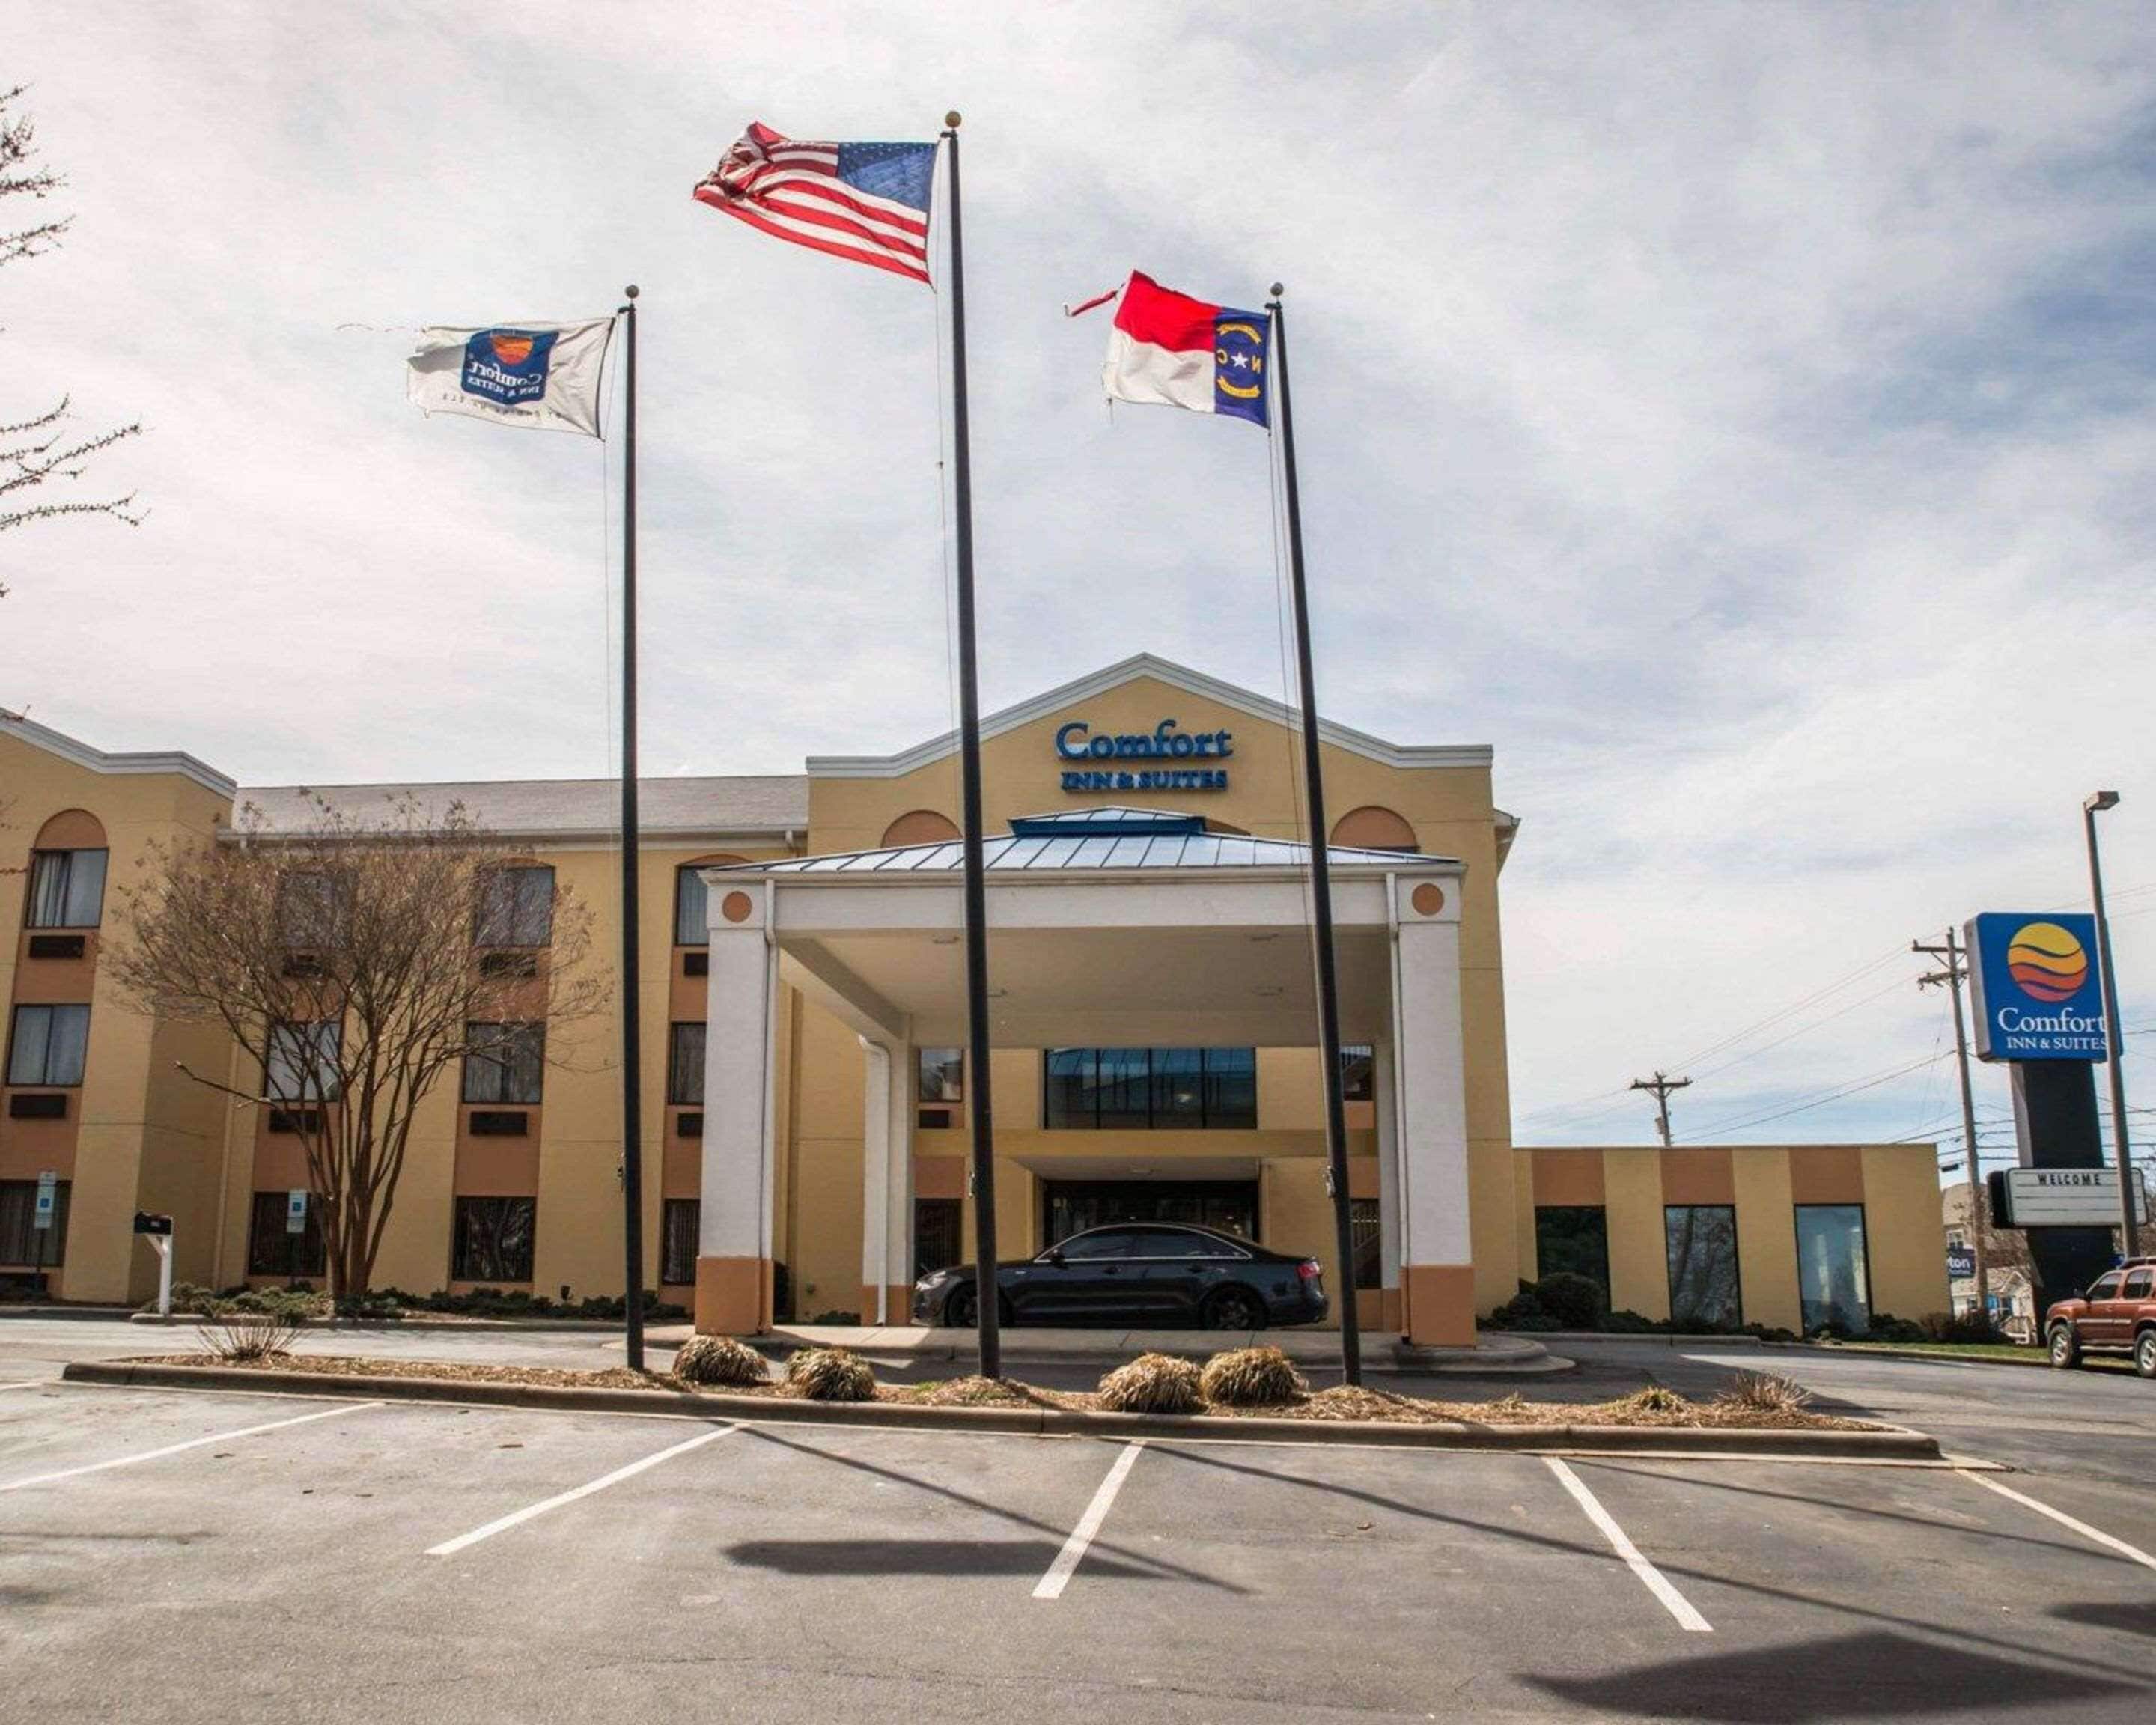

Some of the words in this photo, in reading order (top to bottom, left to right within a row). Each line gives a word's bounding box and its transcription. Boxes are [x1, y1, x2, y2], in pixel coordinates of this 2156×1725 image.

[1056, 719, 1234, 760] Comfort
[1061, 771, 1112, 791] INN
[1116, 771, 1134, 790] &
[1137, 770, 1228, 791] SUITES
[1997, 1007, 2108, 1032] Comfort
[2006, 1037, 2037, 1049] INN
[2039, 1038, 2050, 1050] &
[2053, 1037, 2107, 1050] SUITES
[2038, 1173, 2102, 1186] WELCOME
